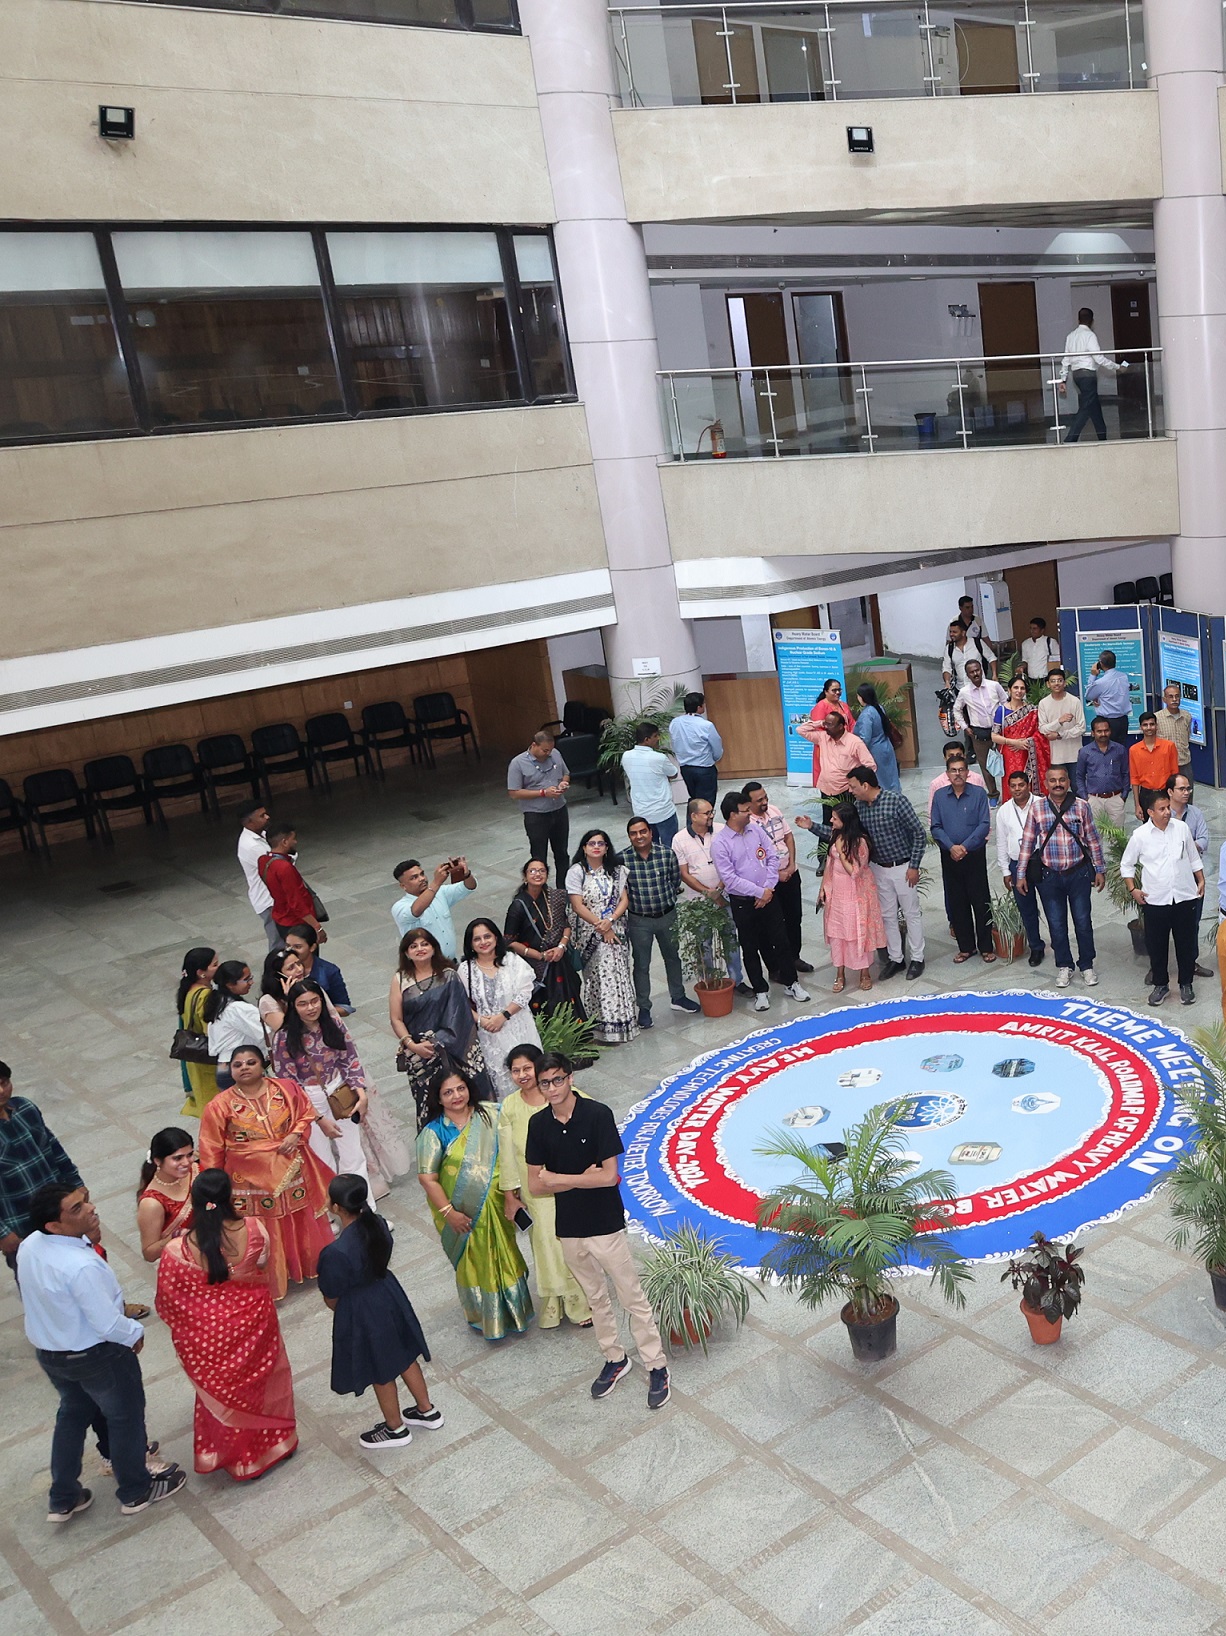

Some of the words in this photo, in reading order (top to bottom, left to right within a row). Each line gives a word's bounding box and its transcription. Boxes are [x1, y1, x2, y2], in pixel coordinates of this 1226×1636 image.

[998, 1021, 1076, 1040] AMRIT
[1070, 1037, 1119, 1062] KAAL
[714, 1037, 782, 1069] CREATING
[736, 1047, 815, 1084] HEAVY
[1060, 1002, 1165, 1044] THEME
[1127, 1136, 1184, 1175] ON
[1107, 1059, 1146, 1115] ROADMAP
[682, 1086, 741, 1129] WATER
[1113, 1116, 1140, 1134] OF
[1071, 1129, 1132, 1173] HEAVY
[625, 1169, 677, 1217] TOMORROW
[981, 1170, 1079, 1209] WATER
